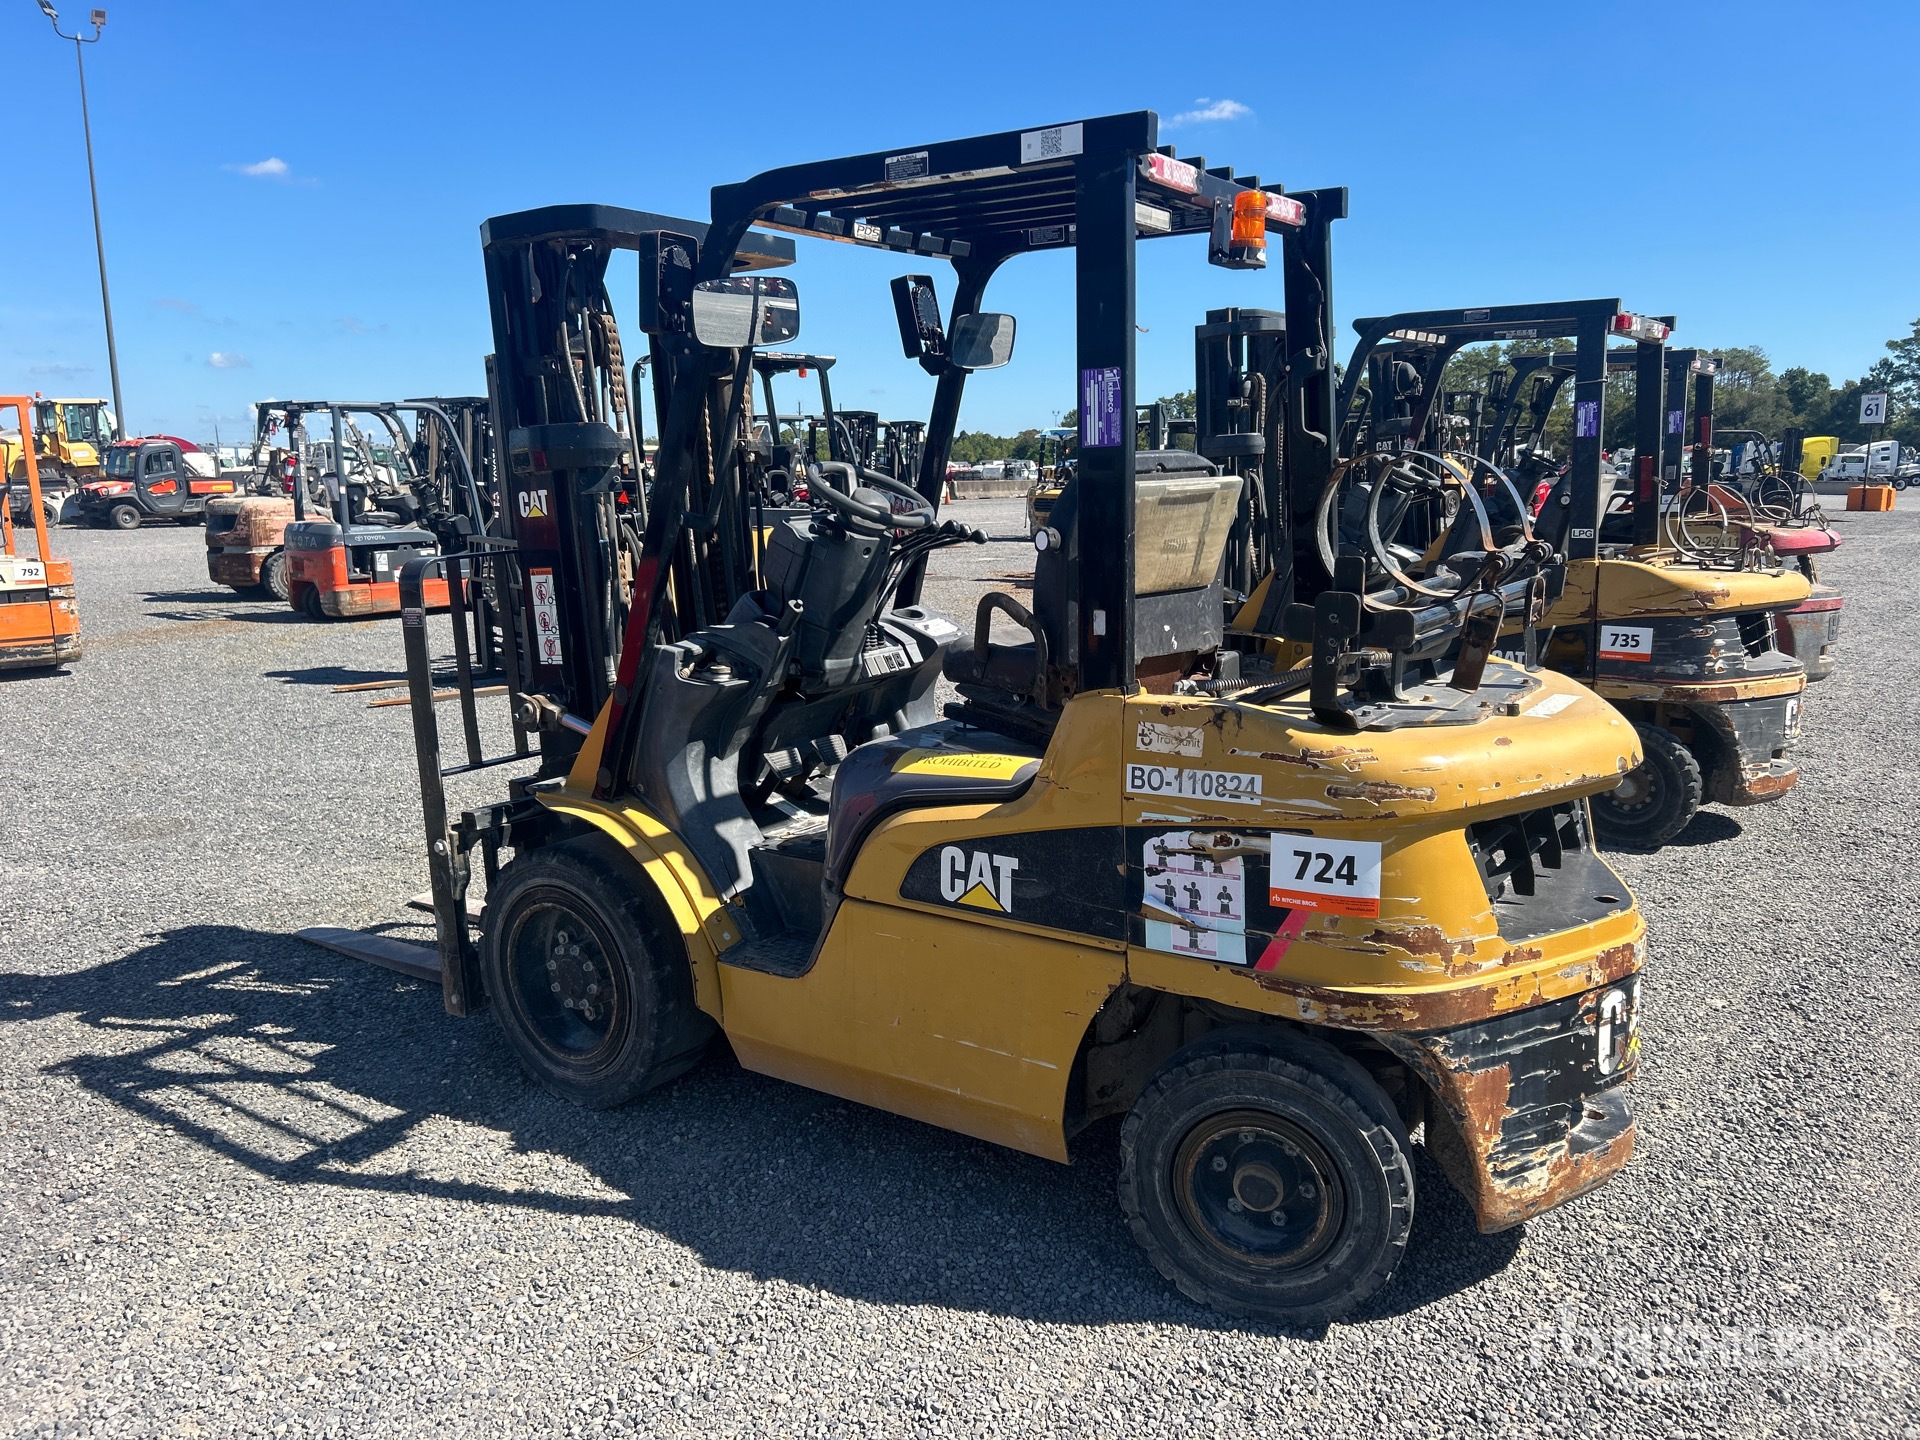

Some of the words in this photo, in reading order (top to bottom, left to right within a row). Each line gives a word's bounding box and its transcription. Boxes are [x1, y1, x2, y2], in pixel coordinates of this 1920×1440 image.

[857, 225, 880, 236] PDS
[1864, 403, 1880, 417] 61
[1376, 440, 1393, 451] CAT
[518, 489, 548, 518] CAT
[1573, 529, 1593, 538] LPG
[21, 568, 40, 577] 792
[1610, 633, 1640, 648] 735
[1156, 733, 1201, 749] Tracunit
[918, 756, 1002, 770] PROHIBITED
[1131, 766, 1257, 800] BO-110824
[1293, 850, 1358, 886] 724
[940, 845, 1019, 914] CAT
[1281, 897, 1302, 905] RITCHIE
